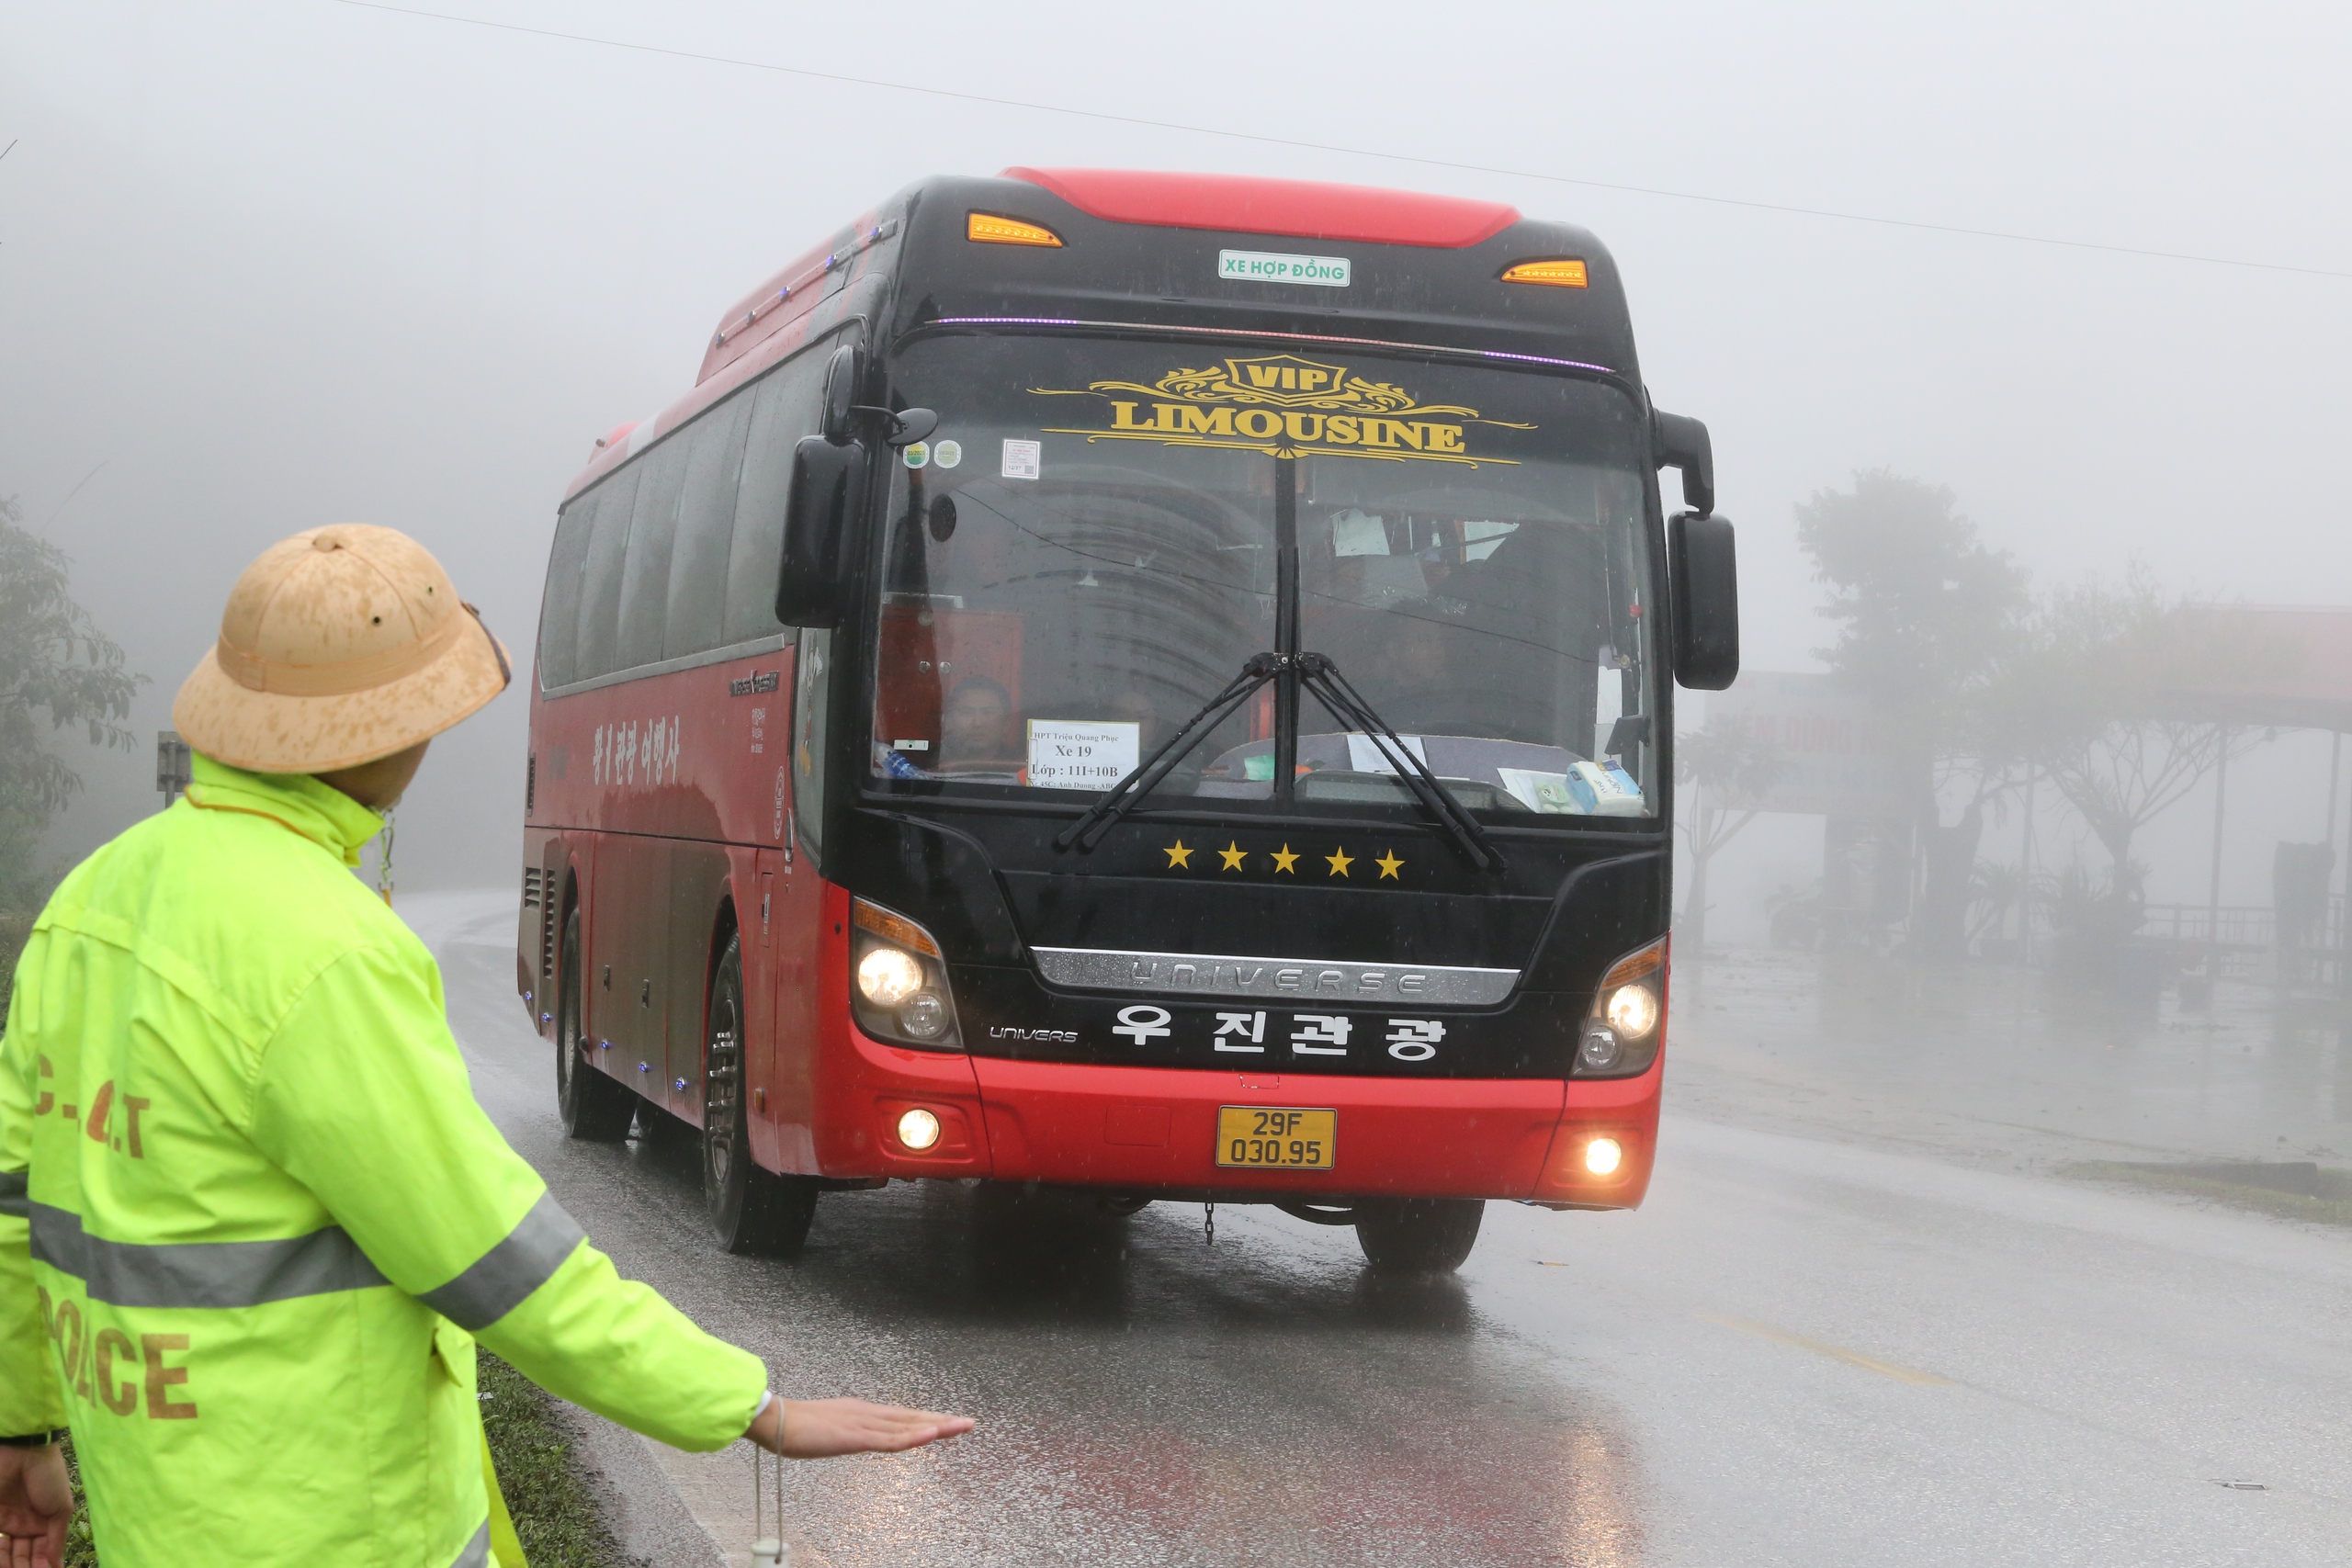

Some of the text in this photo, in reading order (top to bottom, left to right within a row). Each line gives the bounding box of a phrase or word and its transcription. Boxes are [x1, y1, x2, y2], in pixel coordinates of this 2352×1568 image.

[1225, 258, 1345, 280] XE HỢP ĐỒNG
[1247, 365, 1329, 391] VIP
[1110, 400, 1466, 453] LIMOUSINE
[1056, 744, 1091, 758] Xe 19
[1031, 763, 1056, 778] Lớp
[1129, 961, 1427, 995] UNIVERSE
[989, 1026, 1079, 1043] UNIVERS
[1252, 1111, 1303, 1136] 29F
[1231, 1138, 1321, 1165] 030.95
